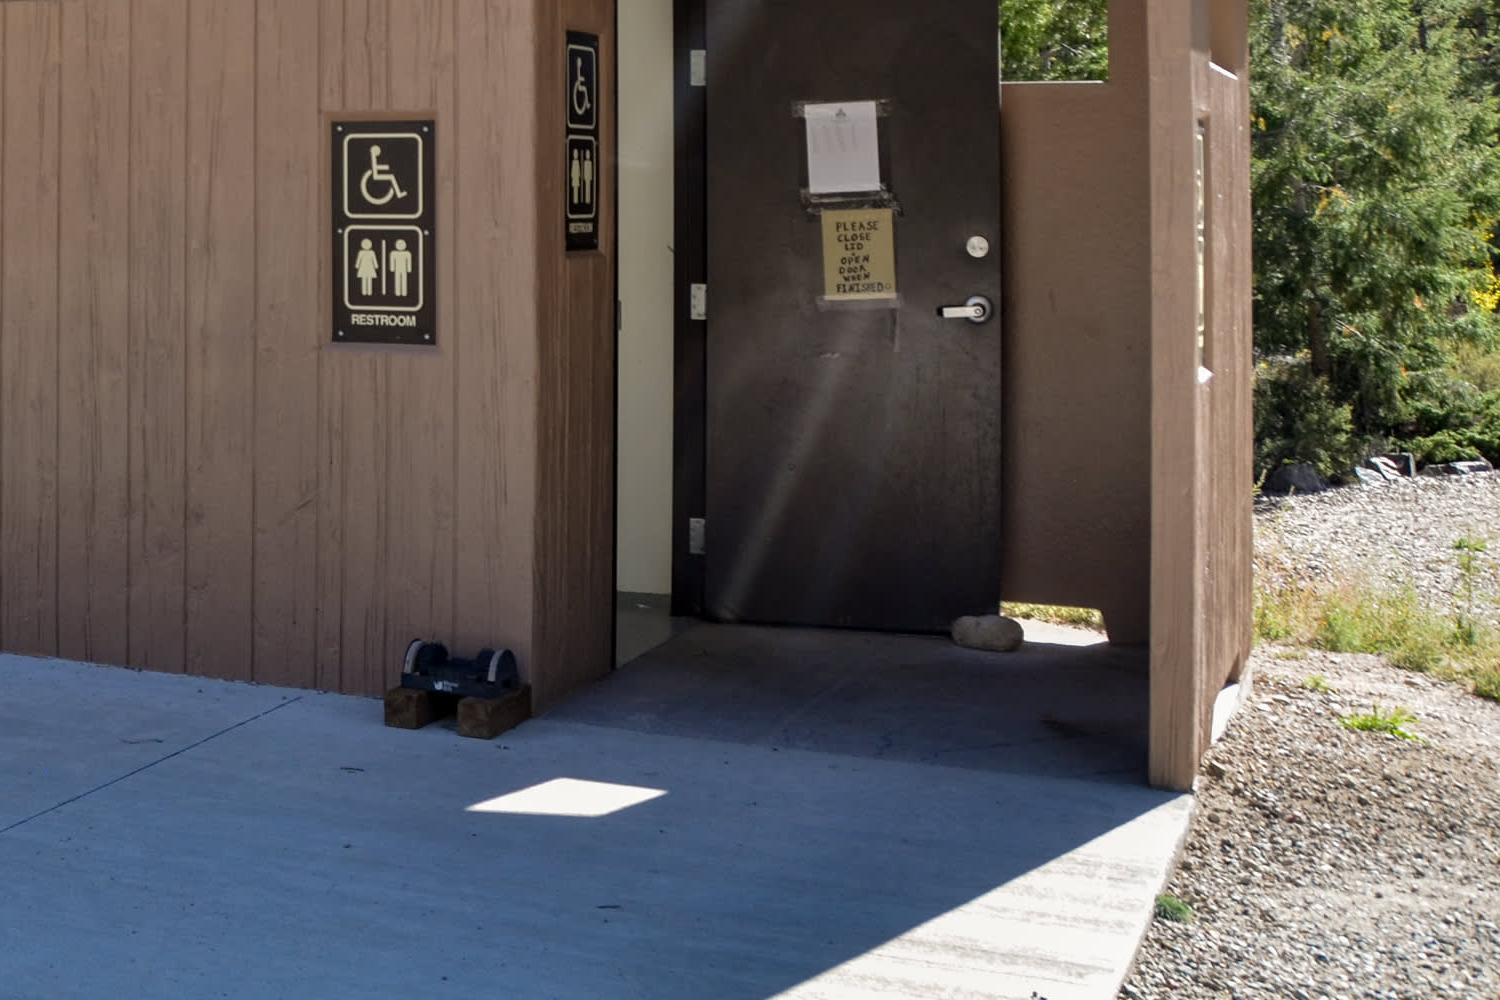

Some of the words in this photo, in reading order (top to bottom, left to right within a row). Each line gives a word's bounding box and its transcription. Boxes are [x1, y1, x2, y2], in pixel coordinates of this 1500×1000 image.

[836, 221, 879, 232] PLEASE
[837, 232, 872, 242] CLOSE
[844, 243, 864, 251] LID
[840, 255, 870, 264] OPEN
[839, 264, 866, 274] DOOR
[843, 272, 870, 282] WHEN
[351, 314, 416, 327] RESTROOM
